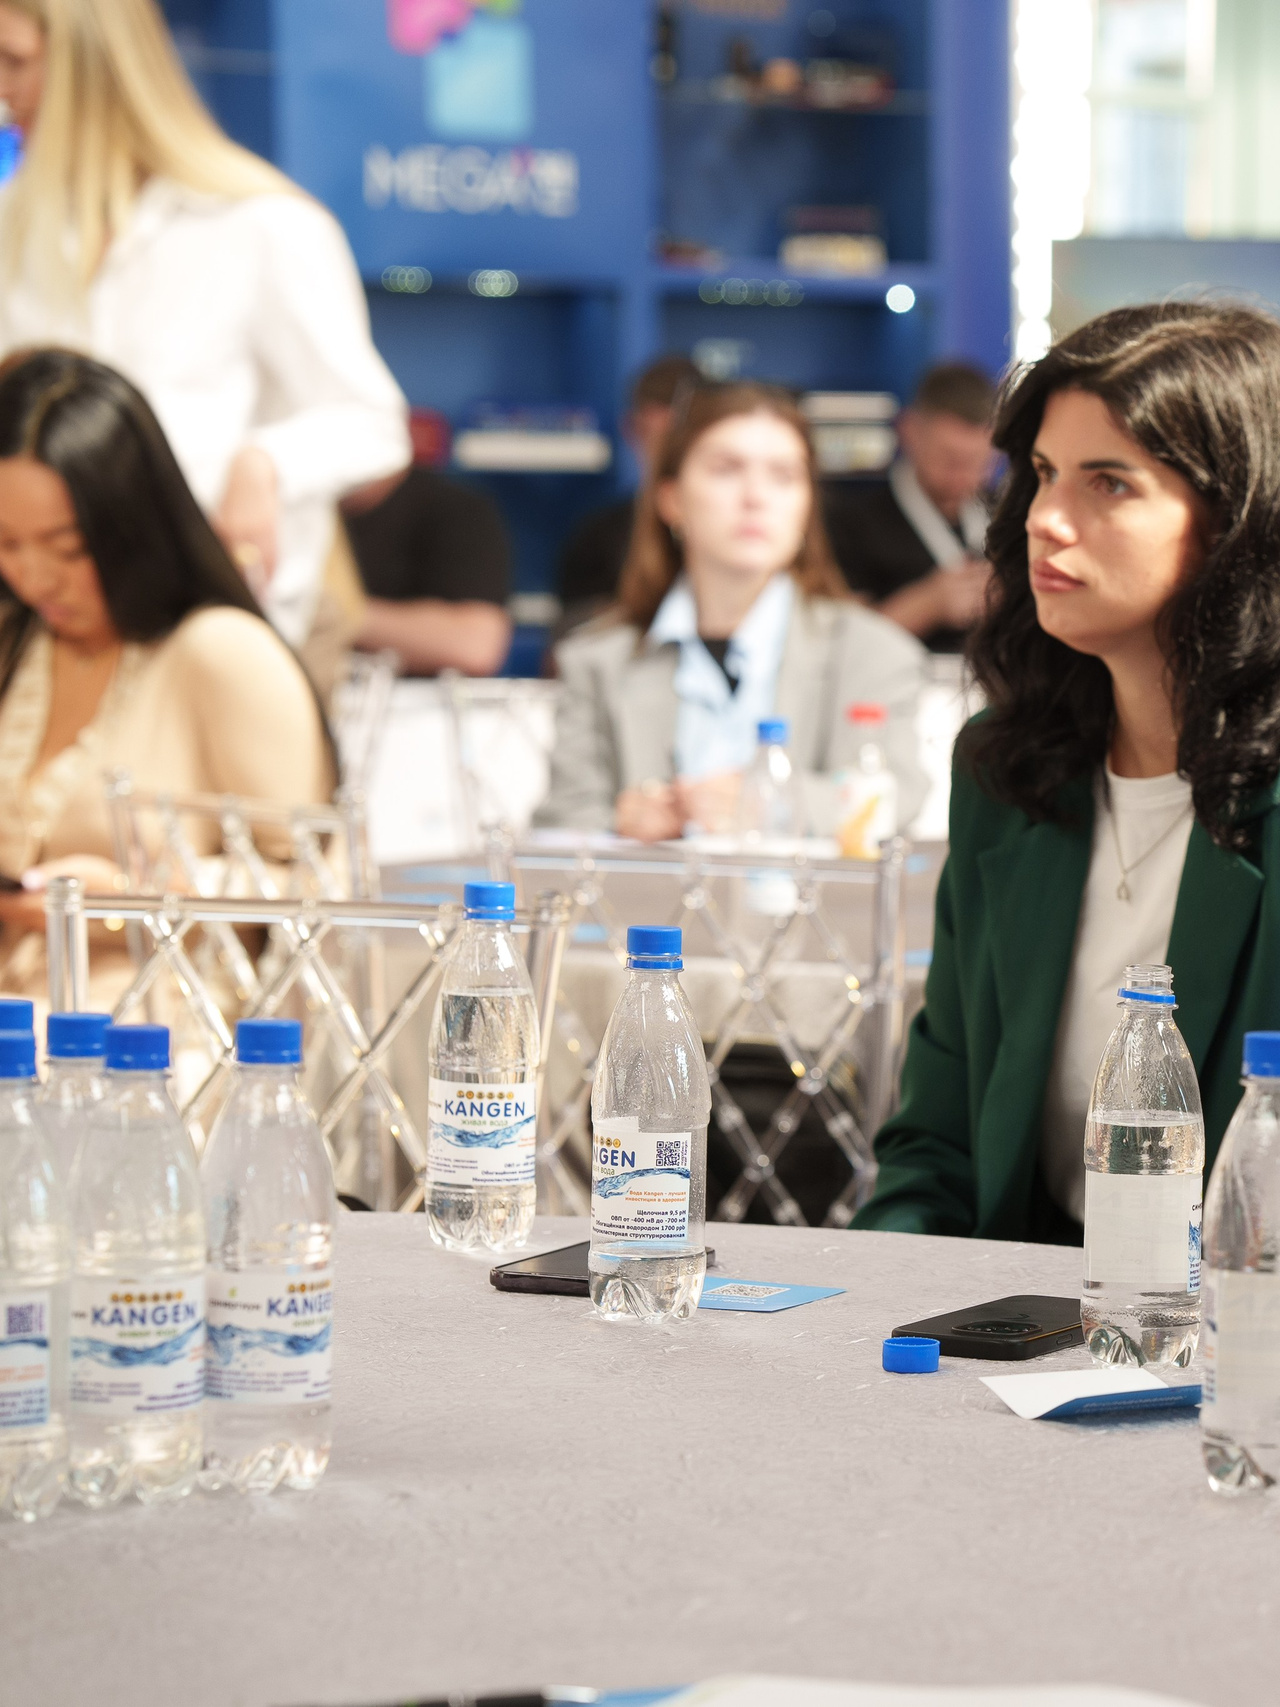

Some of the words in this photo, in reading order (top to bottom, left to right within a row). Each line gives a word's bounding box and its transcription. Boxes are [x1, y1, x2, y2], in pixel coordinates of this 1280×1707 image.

[444, 1099, 525, 1118] KANGEN
[629, 1232, 685, 1240] структурированная
[91, 1301, 197, 1327] KANGEN
